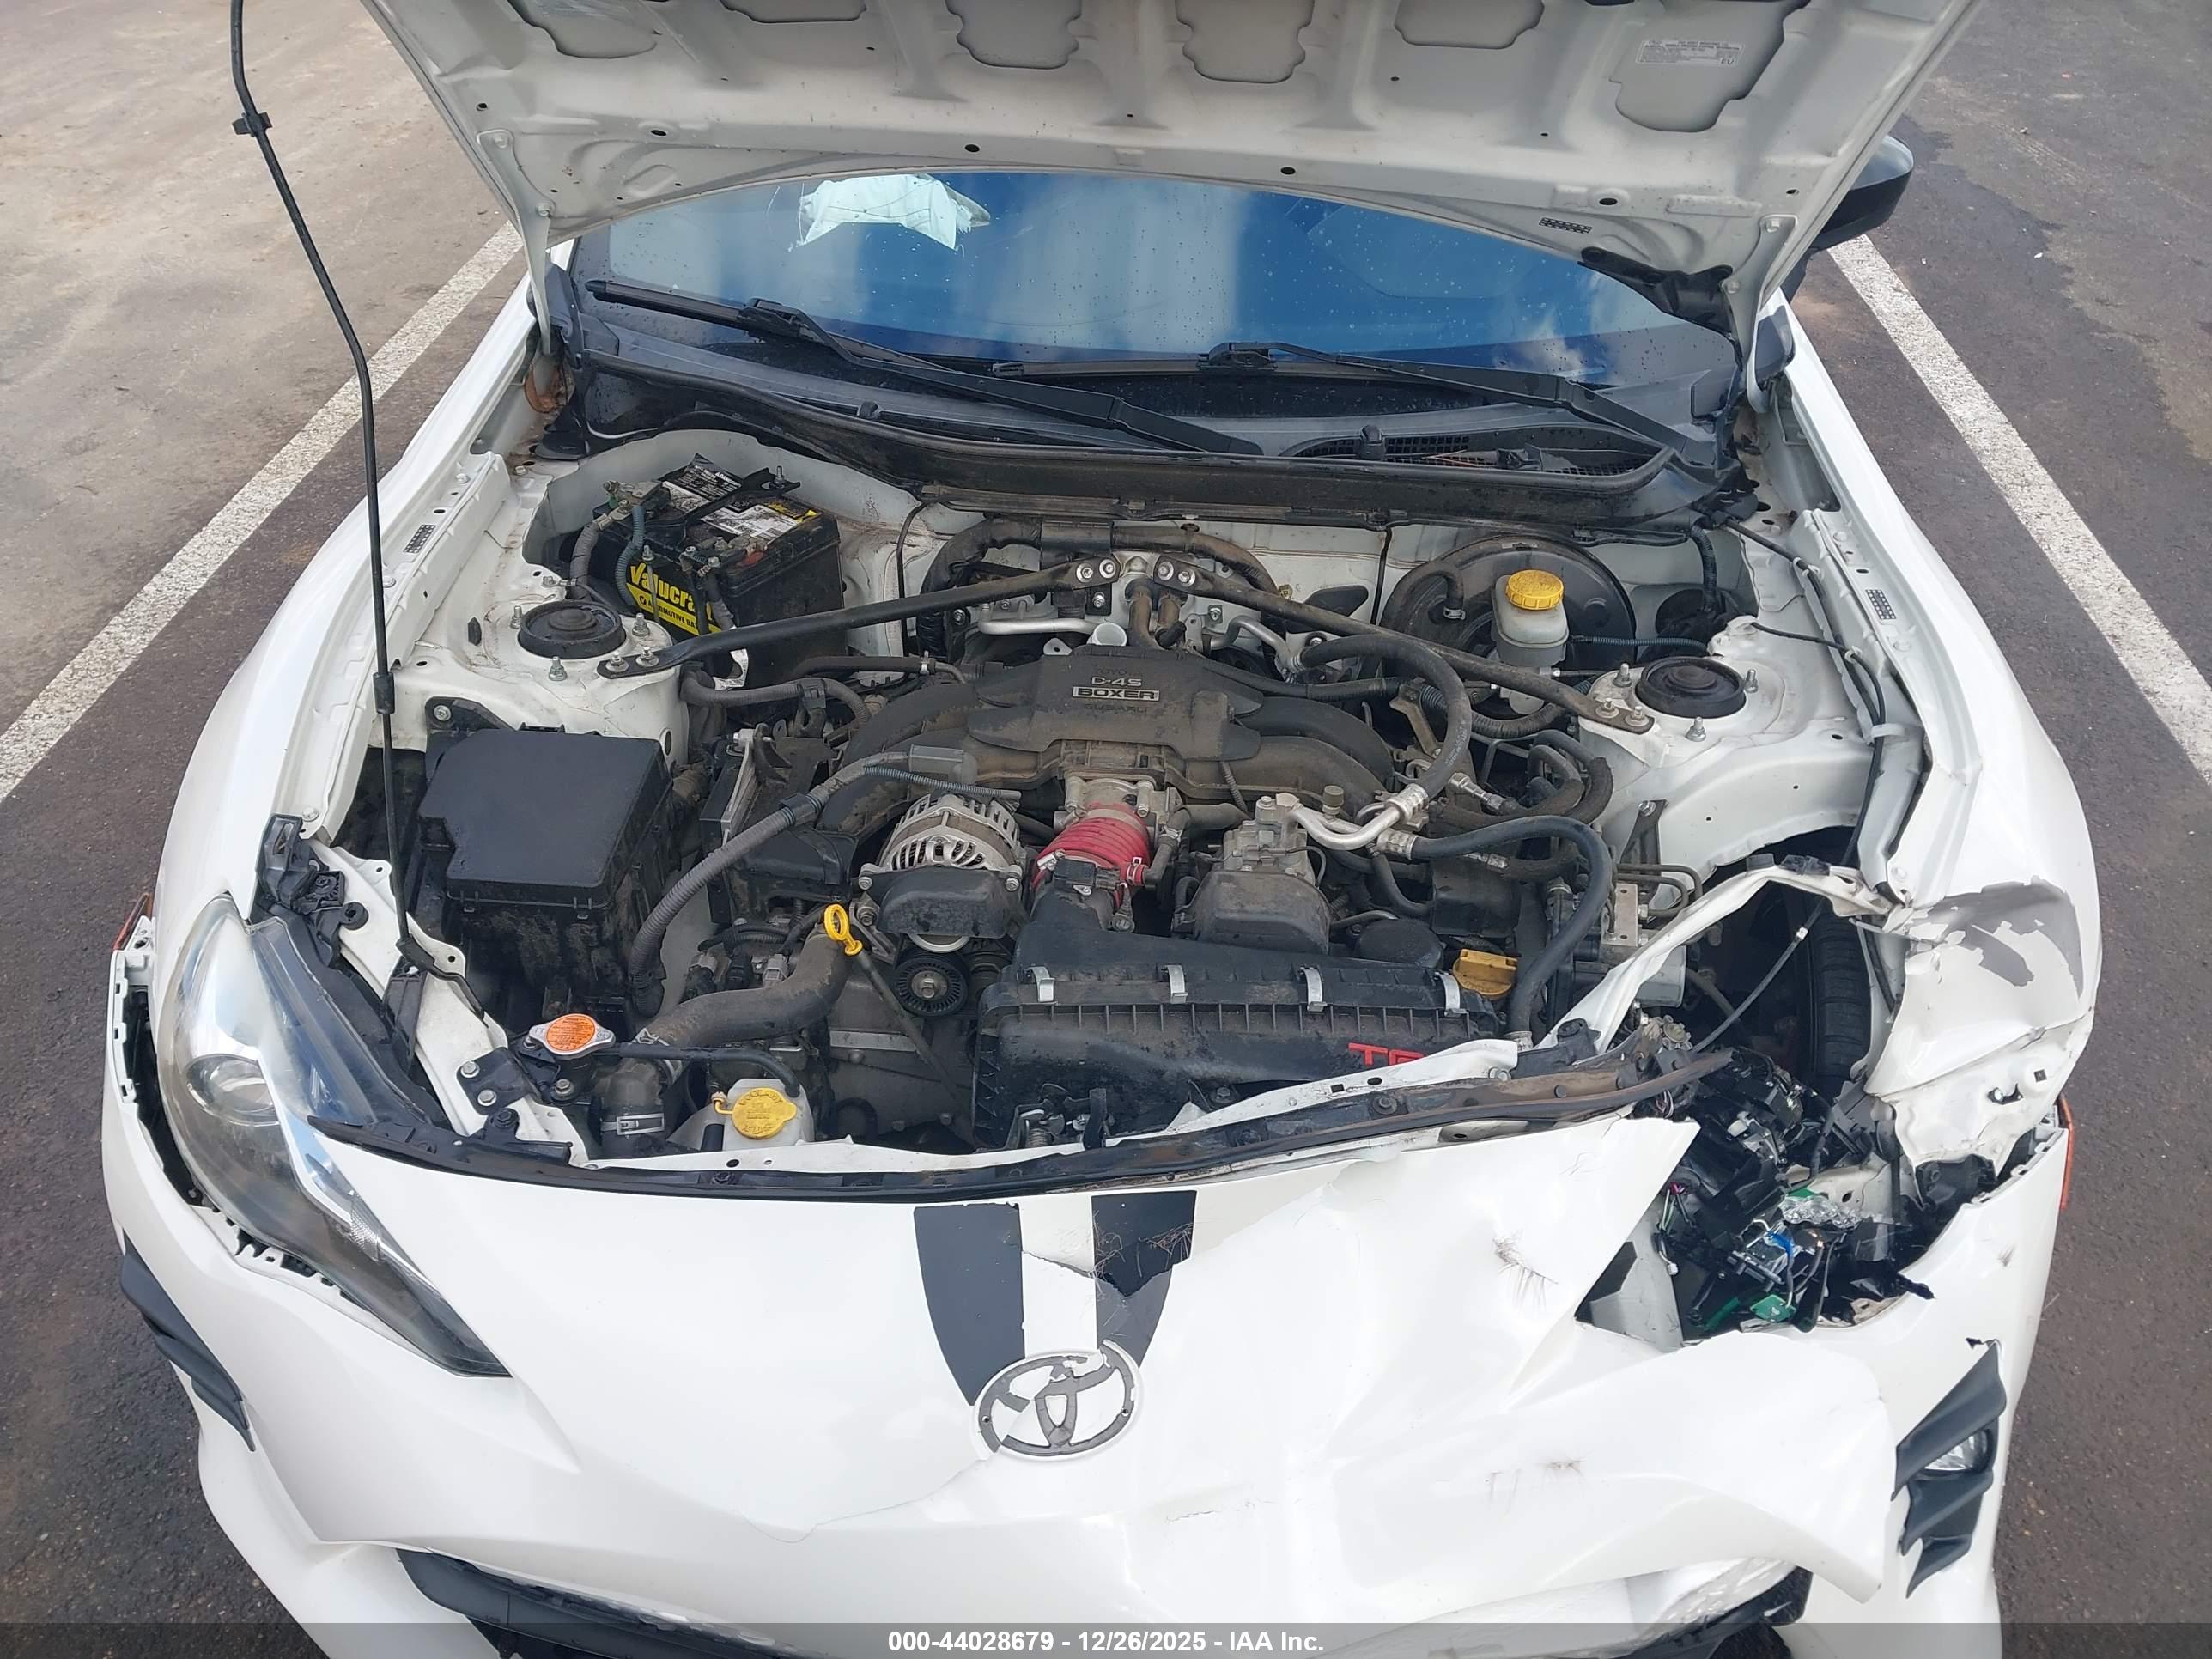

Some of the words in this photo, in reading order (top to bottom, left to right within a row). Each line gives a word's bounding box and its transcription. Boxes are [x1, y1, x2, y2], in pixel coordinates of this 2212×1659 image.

[630, 562, 704, 617] Valucra
[648, 599, 686, 624] AOMOTIVE
[1091, 677, 1142, 686] D-4S
[1078, 689, 1155, 699] BOXER
